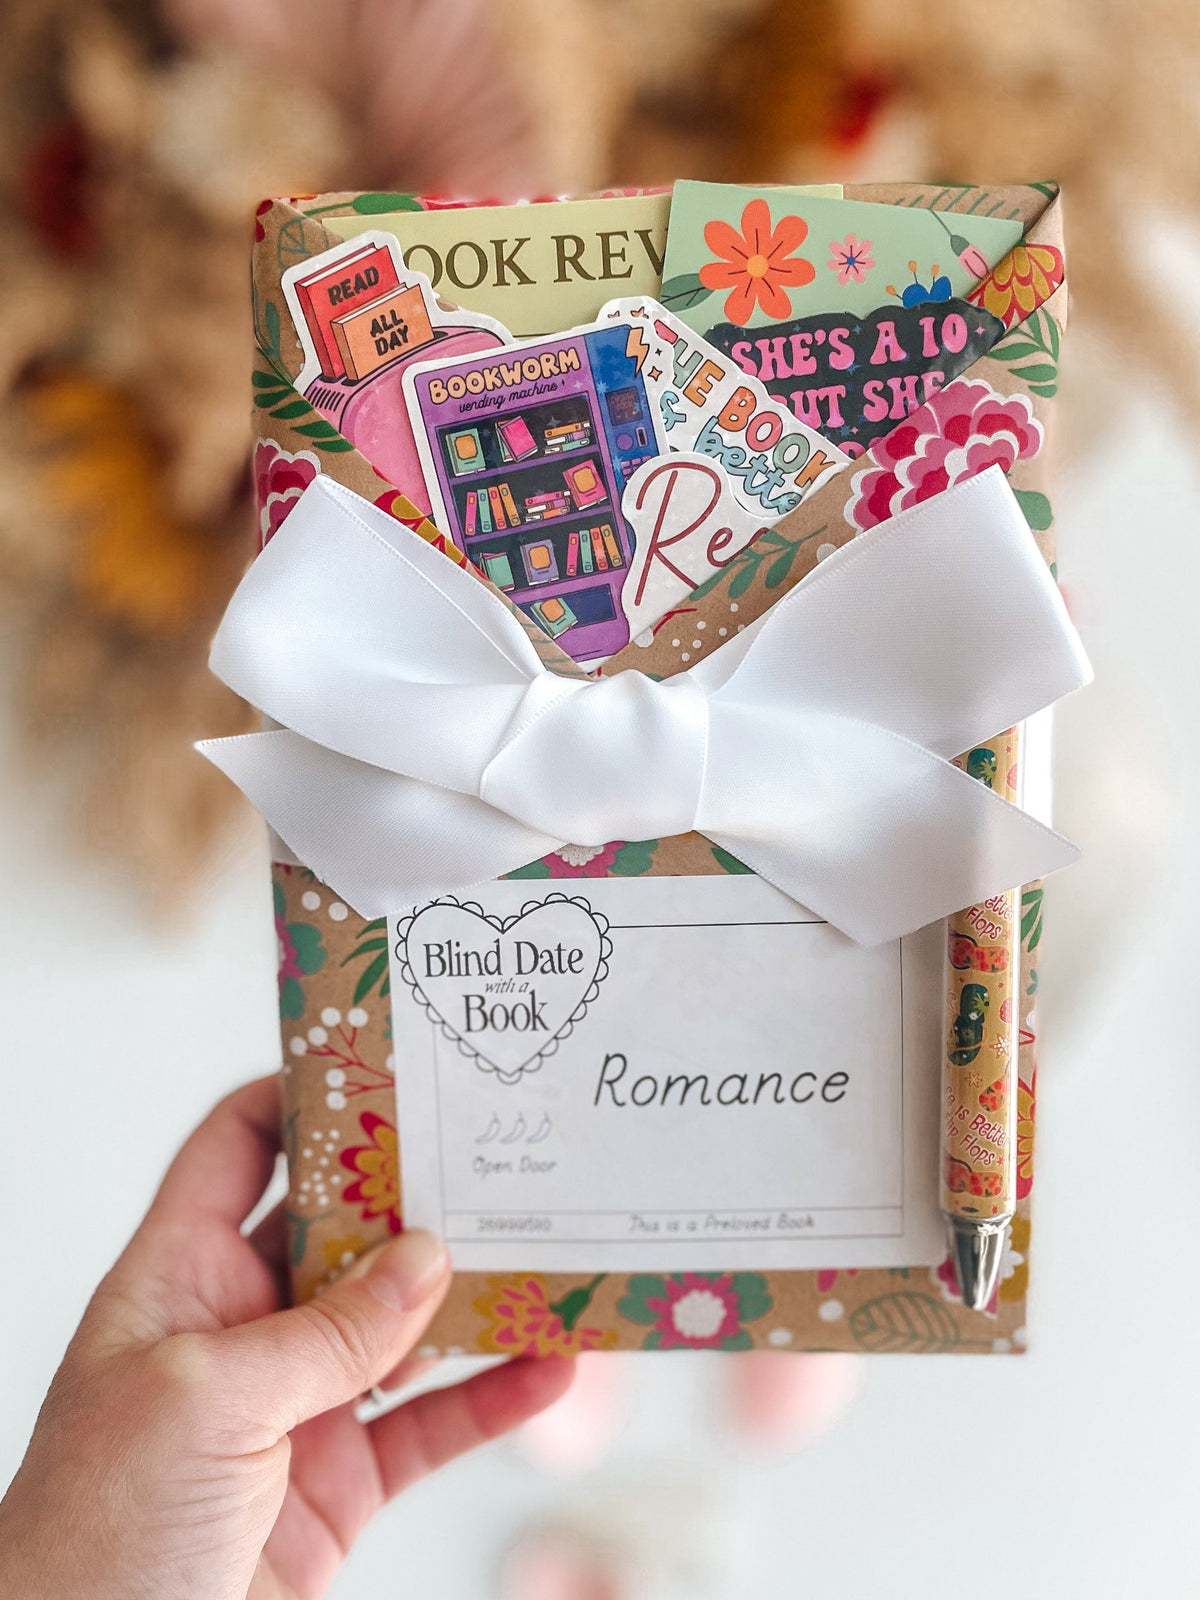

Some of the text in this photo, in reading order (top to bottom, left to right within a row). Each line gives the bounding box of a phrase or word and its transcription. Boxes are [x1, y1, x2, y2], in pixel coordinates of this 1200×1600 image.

[327, 266, 380, 306] READ
[370, 309, 404, 338] ALL
[374, 325, 409, 356] DAY
[869, 321, 907, 365] A
[919, 313, 968, 358] 10
[428, 347, 581, 405] BOOKWORM
[459, 380, 558, 413] vending machine
[770, 385, 846, 429] UT
[964, 906, 1002, 940] Flops
[422, 938, 585, 978] Blind Date
[485, 978, 530, 994] with a
[462, 990, 551, 1033] Book
[594, 1053, 850, 1107] Romance
[472, 1154, 557, 1179] Open Door
[959, 1134, 996, 1166] Flops
[629, 1211, 815, 1232] This is a Preloved Book
